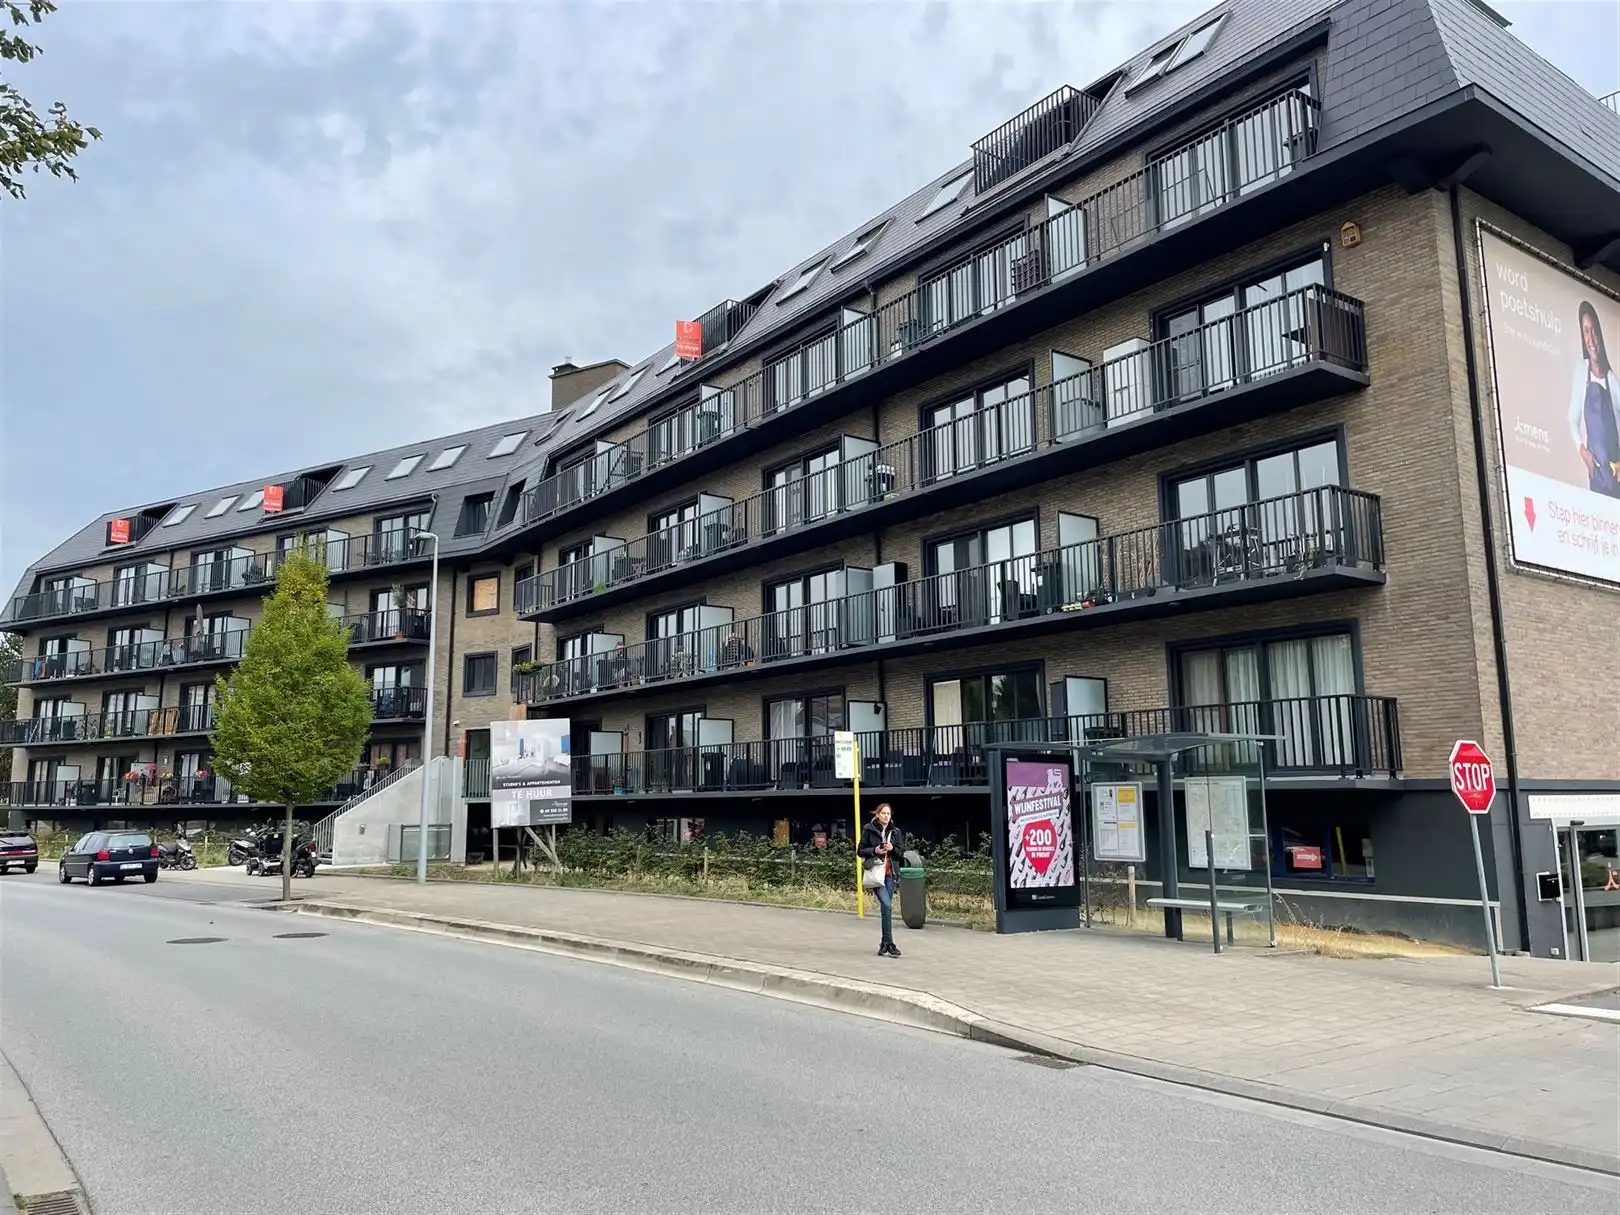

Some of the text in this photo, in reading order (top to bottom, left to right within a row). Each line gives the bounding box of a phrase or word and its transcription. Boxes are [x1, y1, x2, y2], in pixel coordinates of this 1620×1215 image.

[1495, 262, 1528, 292] word
[1548, 500, 1570, 527] Stap
[1454, 762, 1490, 791] STOP
[511, 788, 552, 799] TE HUUR
[1014, 795, 1061, 815] WIJNFESTIVAL
[1024, 828, 1052, 846] +200
